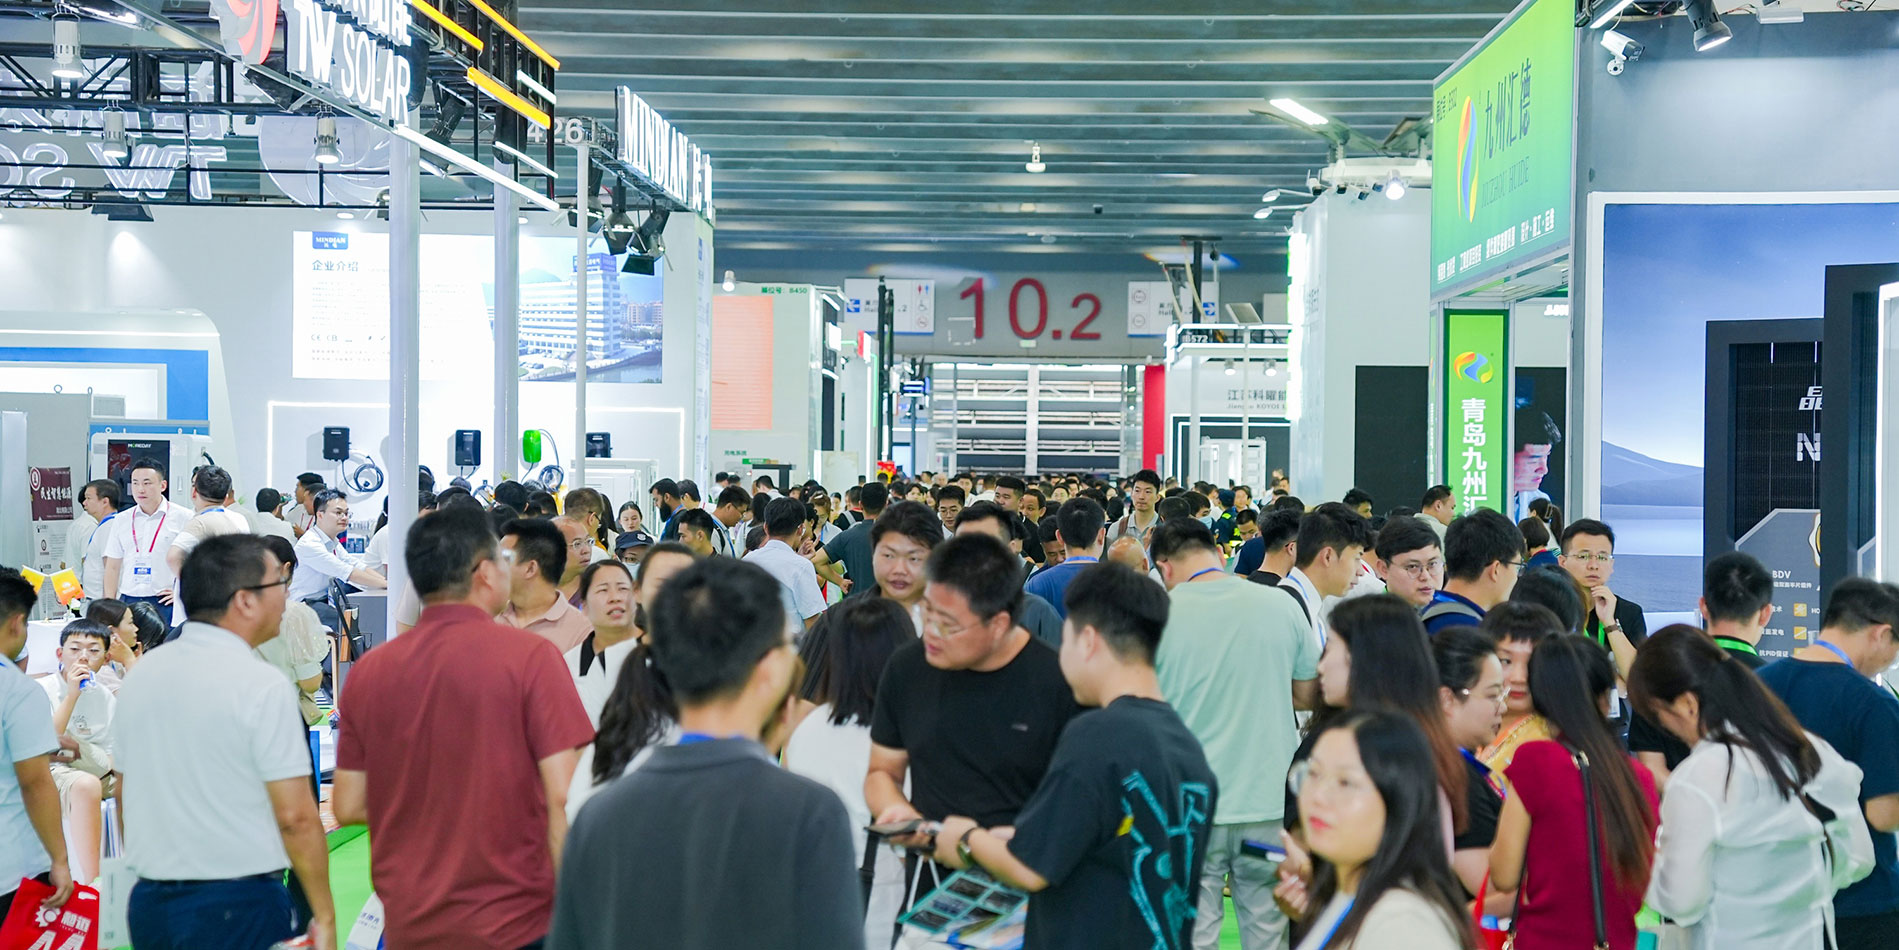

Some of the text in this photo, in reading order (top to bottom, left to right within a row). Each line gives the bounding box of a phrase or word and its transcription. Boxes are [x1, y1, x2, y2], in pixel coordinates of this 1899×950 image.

[294, 0, 337, 83] TW
[341, 23, 411, 127] SOLAR
[1483, 57, 1531, 161] 九州汇德
[624, 85, 688, 203] MINDIAN
[312, 259, 359, 272] 企业介绍
[960, 277, 1102, 341] 10.2
